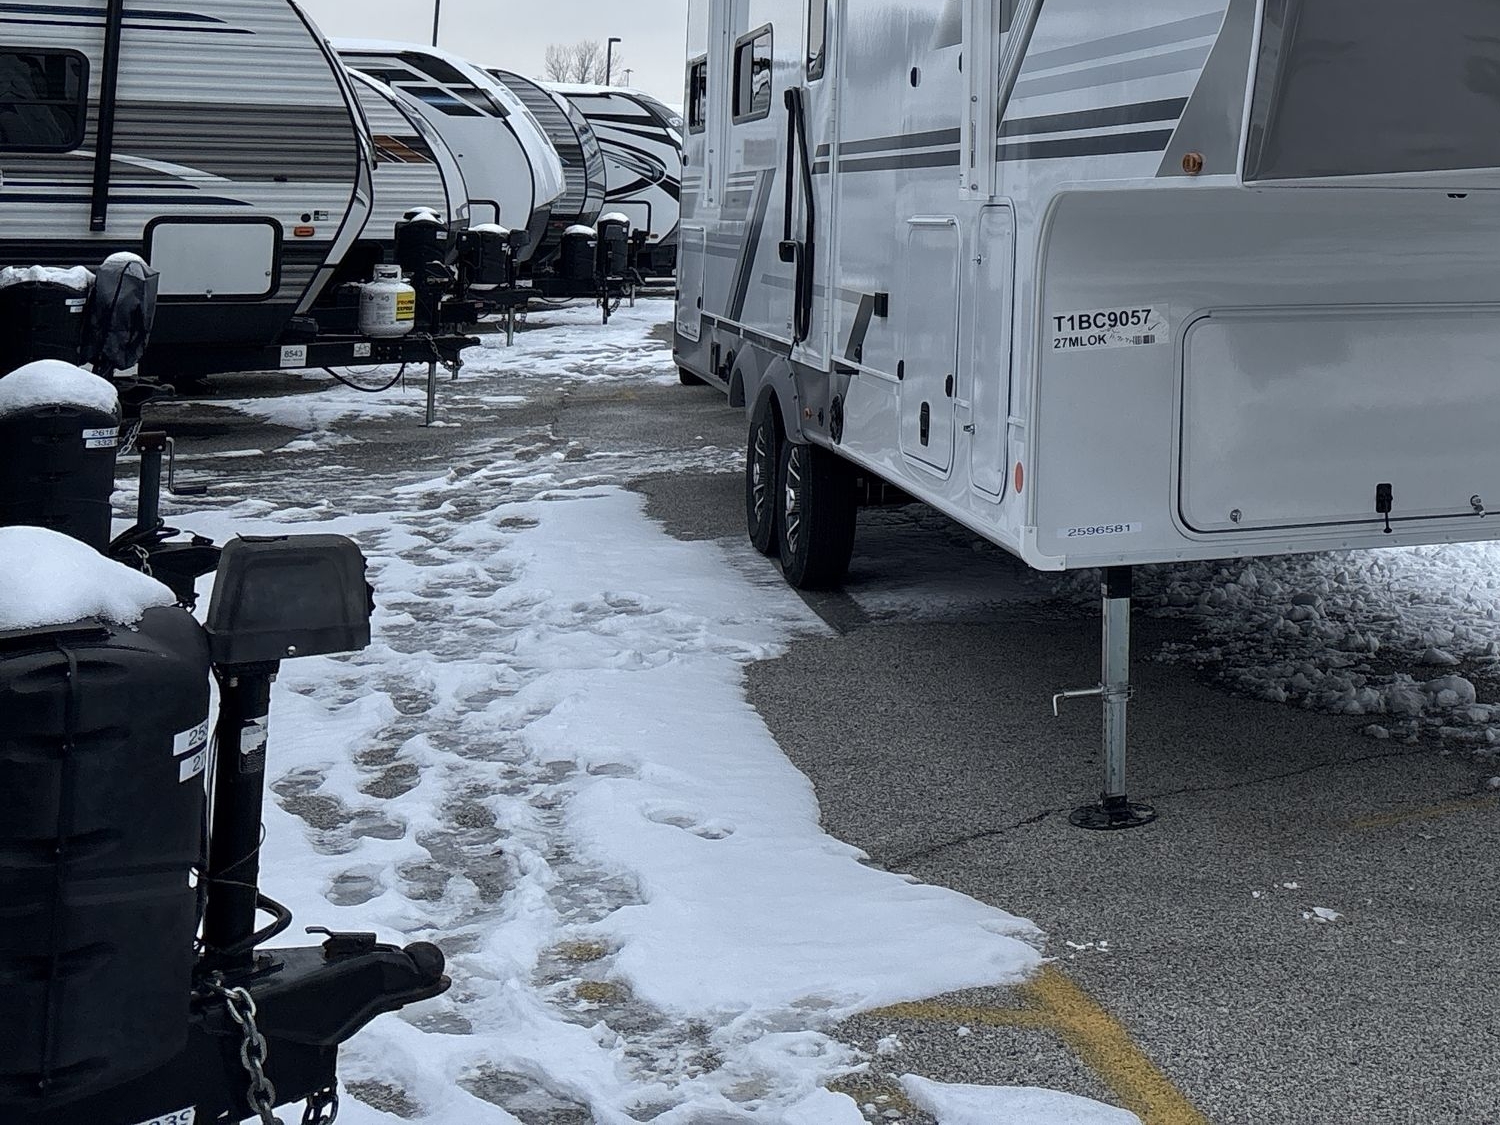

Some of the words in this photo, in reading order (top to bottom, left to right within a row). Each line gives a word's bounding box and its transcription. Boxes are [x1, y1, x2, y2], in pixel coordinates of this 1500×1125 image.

[1053, 309, 1151, 332] T1BC9057
[1054, 334, 1107, 348] 27MLOK
[1068, 524, 1130, 536] 2596581
[188, 724, 208, 746] 25
